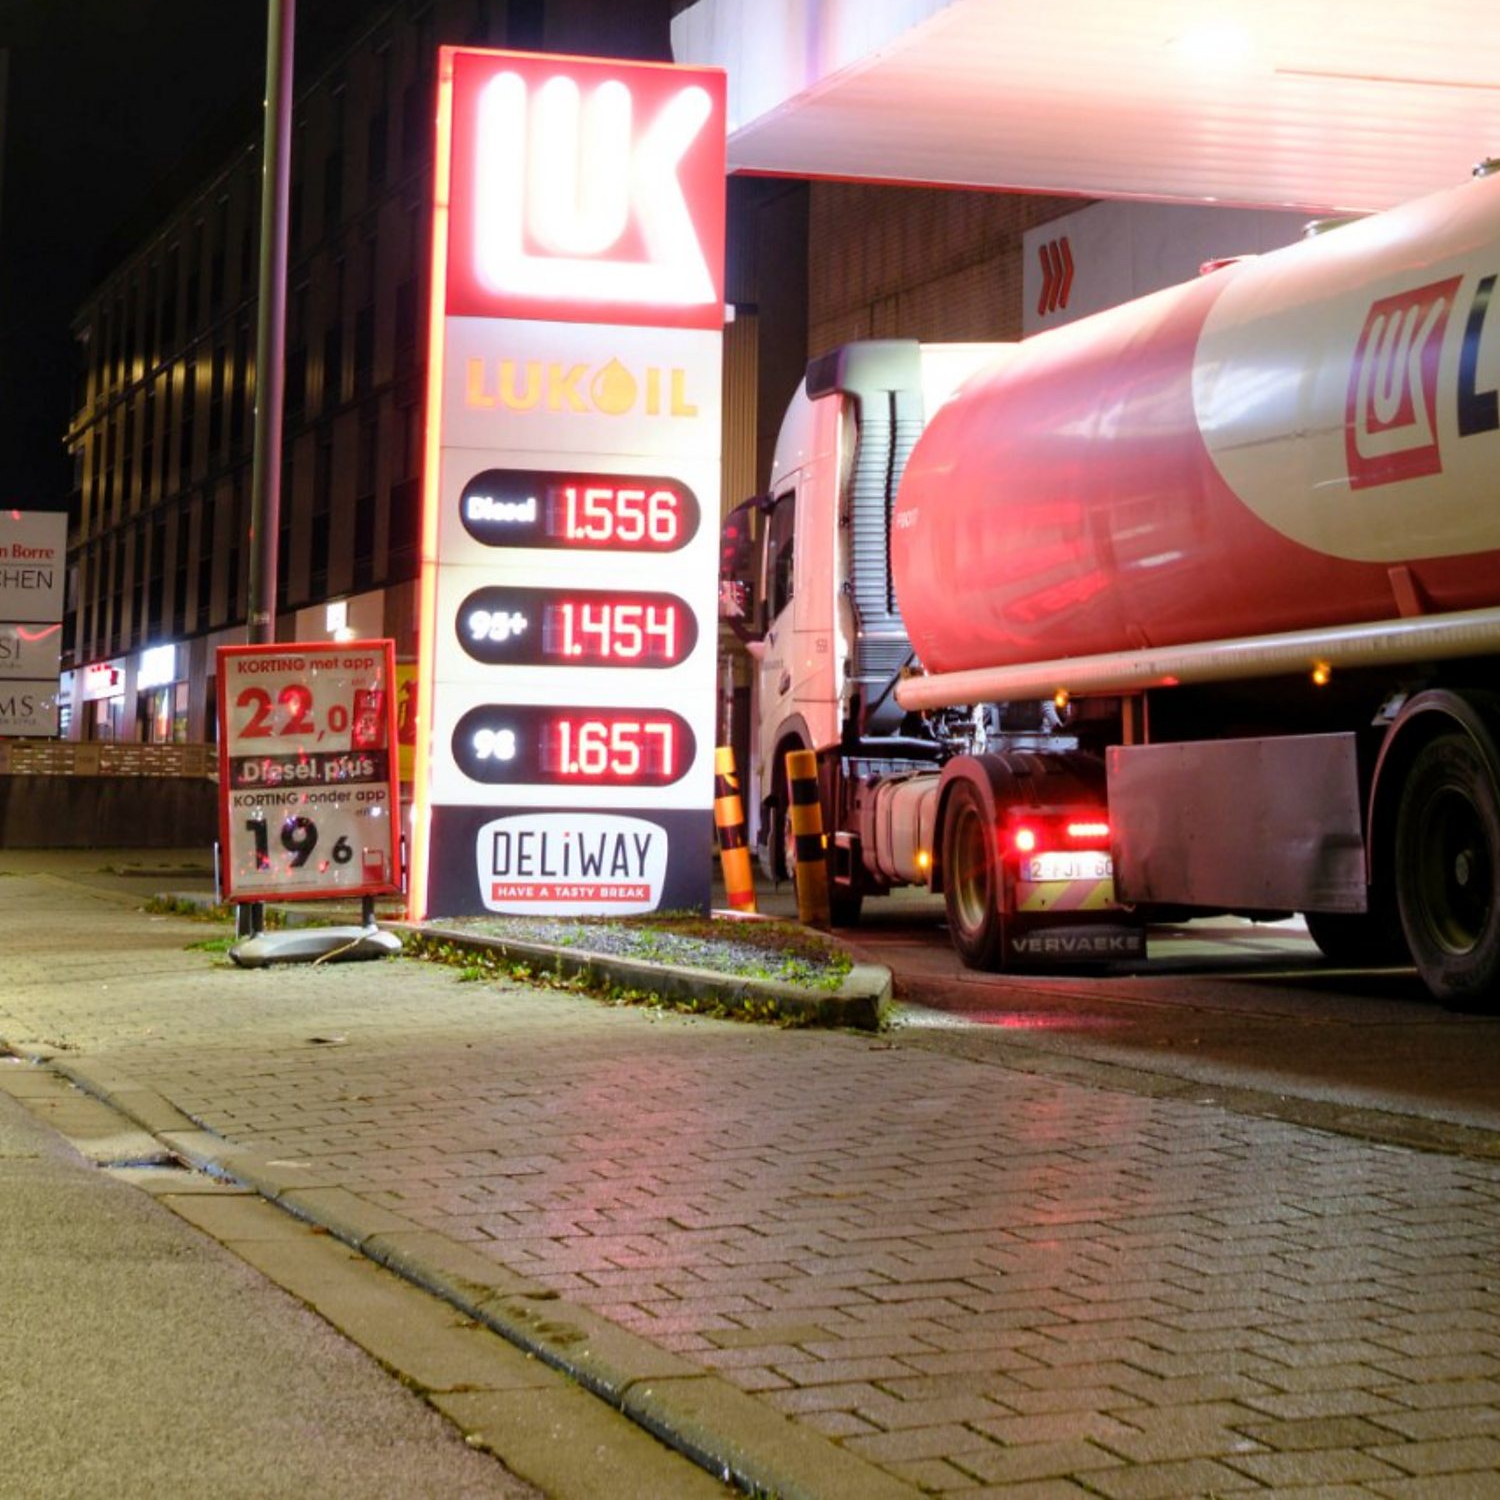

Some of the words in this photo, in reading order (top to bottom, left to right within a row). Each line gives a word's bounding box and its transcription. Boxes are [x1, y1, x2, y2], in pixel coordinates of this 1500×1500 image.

[475, 71, 718, 304] LUK
[465, 357, 698, 418] LUKOIL
[1352, 295, 1447, 461] LUK
[564, 487, 678, 542] 1.556
[13, 545, 54, 559] Borre
[562, 604, 676, 658] 1.454
[238, 658, 305, 674] KORTING
[310, 658, 339, 670] met
[343, 657, 374, 671] app
[236, 684, 348, 742] 22,0
[243, 758, 317, 782] Diesel
[558, 721, 673, 775] 1.657
[234, 792, 298, 807] KORTING
[355, 789, 386, 803] app
[498, 887, 535, 898] HAVE
[539, 887, 549, 898] A
[554, 887, 595, 898] TASTY
[600, 887, 645, 898] BREAK
[1011, 936, 1141, 953] VERVAEKE
